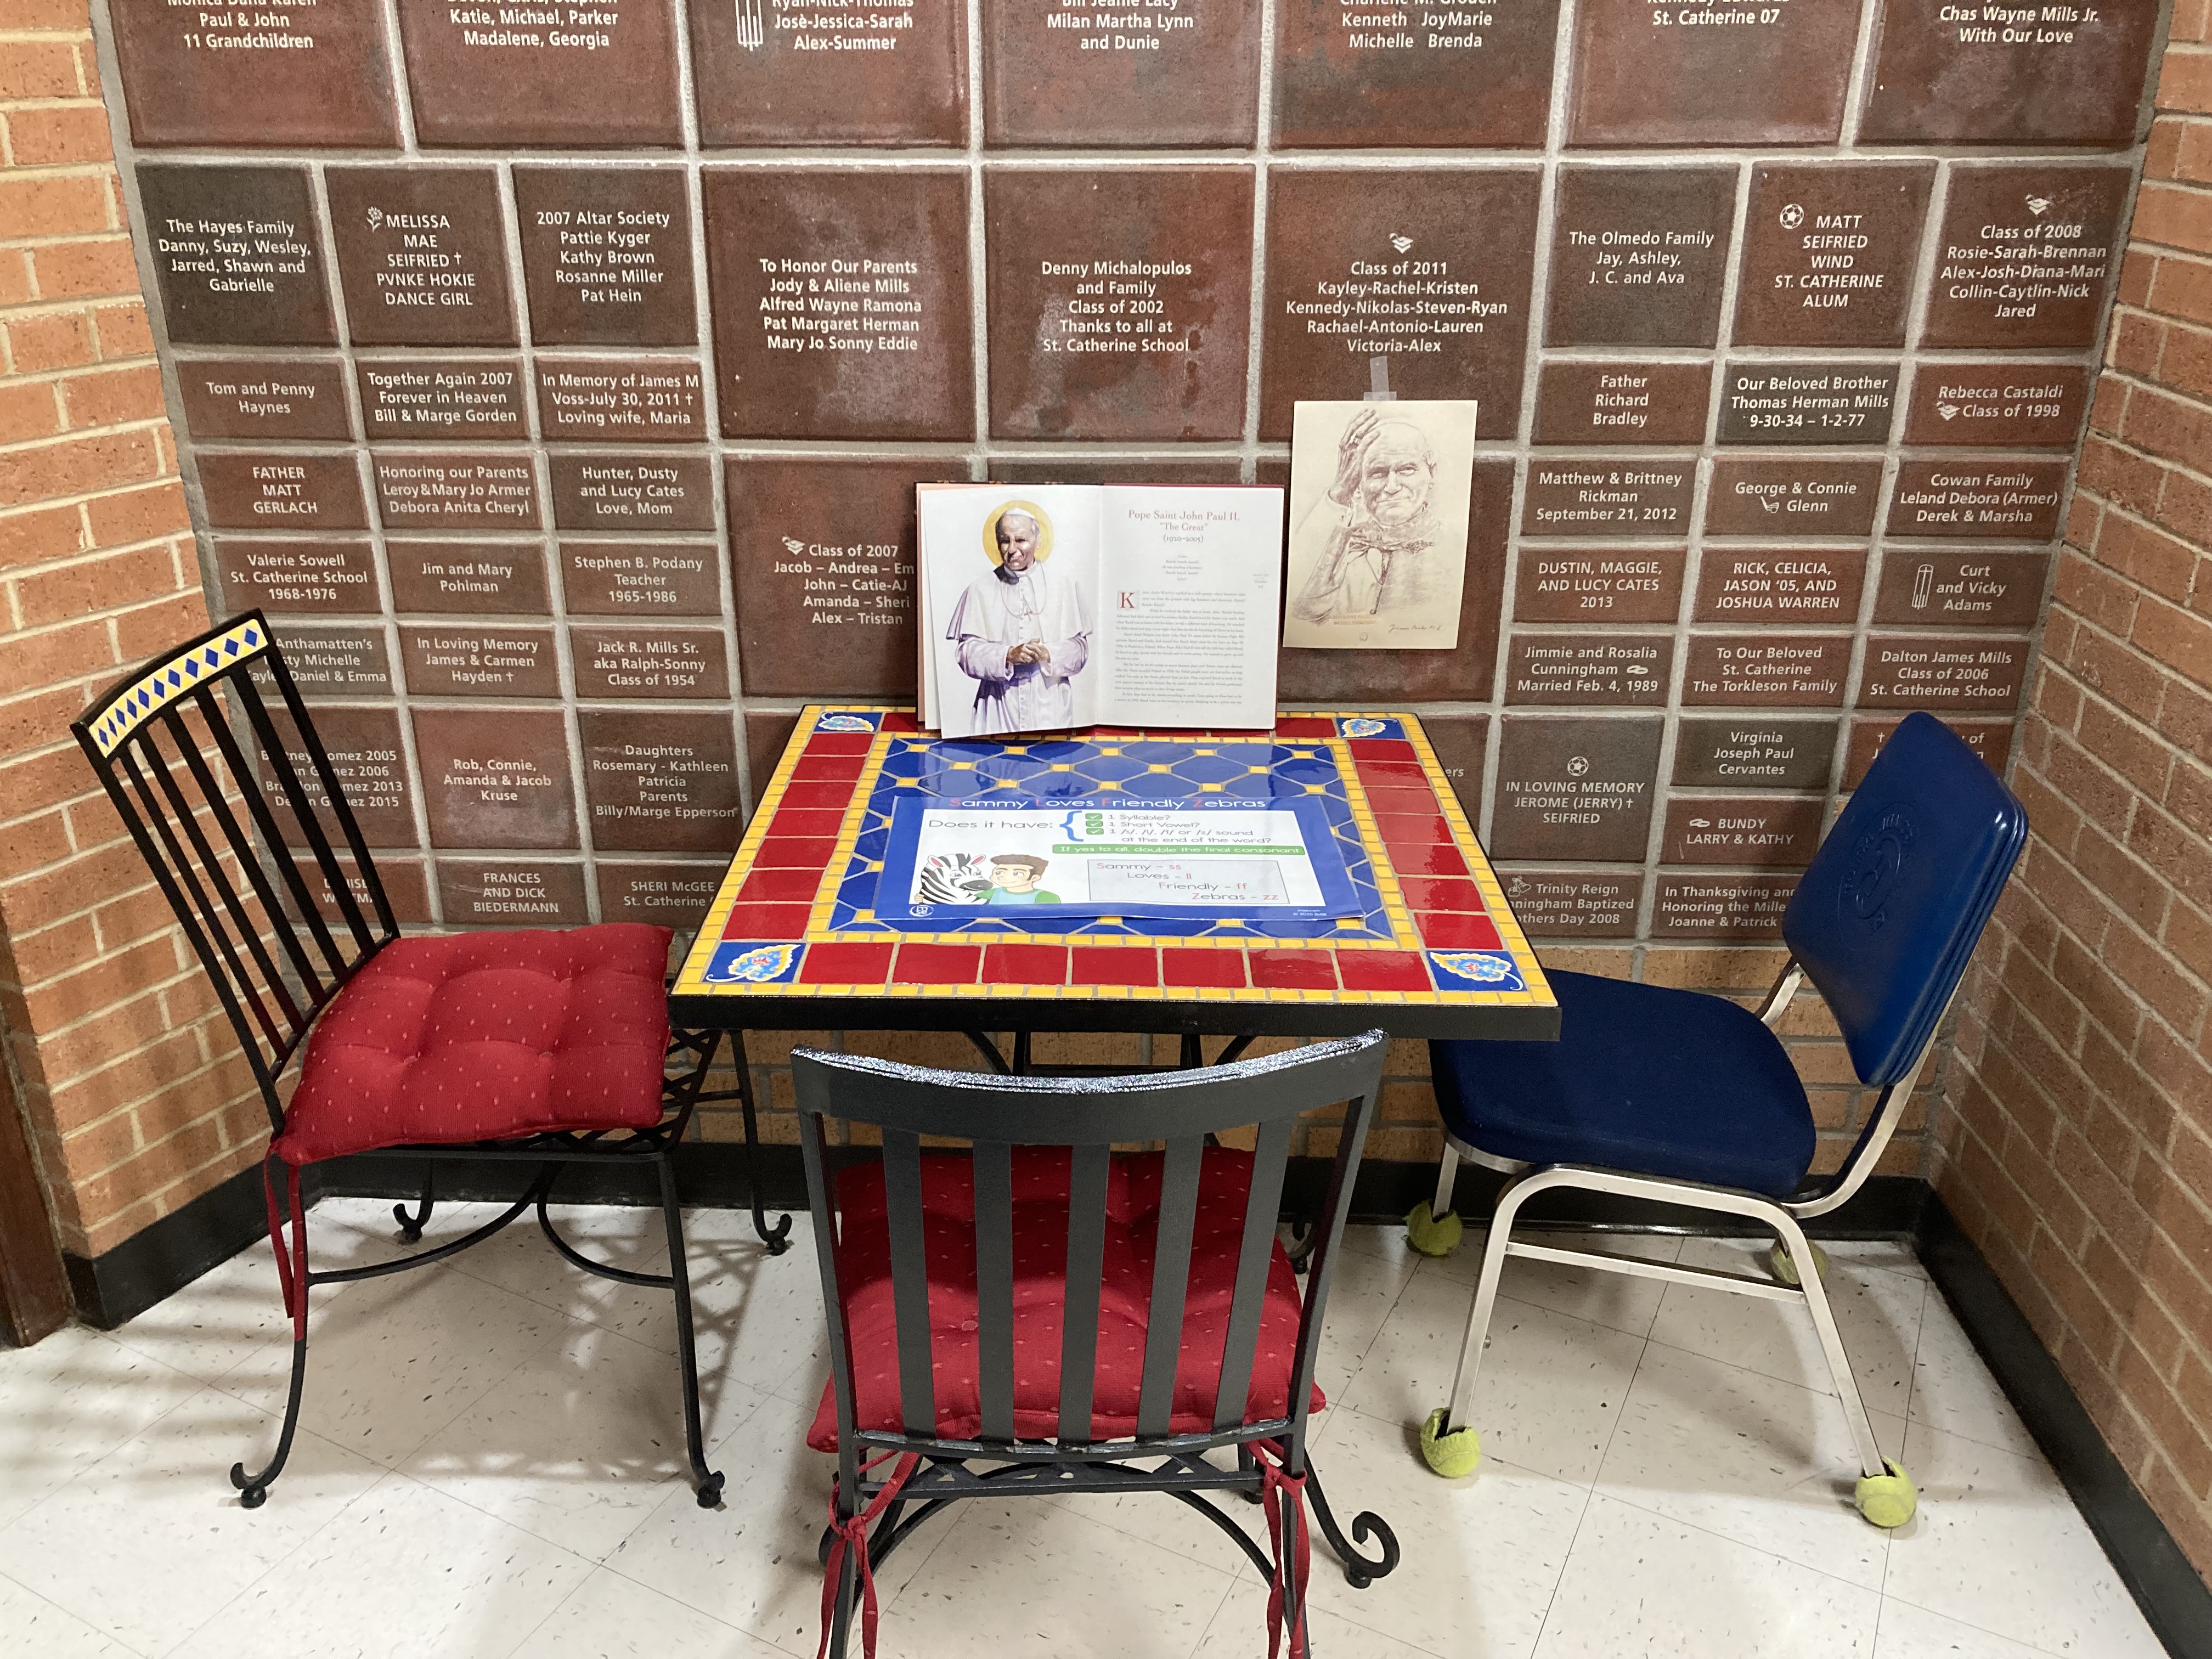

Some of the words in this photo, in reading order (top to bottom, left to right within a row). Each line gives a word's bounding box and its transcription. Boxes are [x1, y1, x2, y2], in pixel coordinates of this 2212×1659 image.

[199, 10, 233, 27] Paul
[237, 12, 250, 28] &
[253, 10, 291, 29] John
[1341, 10, 1408, 27] Kenneth
[1420, 10, 1493, 31] JoyMarie
[1652, 9, 1673, 26] St.
[1678, 8, 1756, 26] Catherine
[1759, 8, 1781, 25] 07
[183, 33, 201, 49] 11
[205, 32, 314, 50] Grandchildren
[793, 33, 897, 50] Alex-Summer
[1348, 32, 1414, 49] Michelle
[1427, 31, 1482, 48] Brenda
[165, 218, 194, 234] The
[198, 219, 242, 237] Hayes
[246, 219, 296, 238] Family
[386, 214, 451, 229] MELISSA
[1815, 215, 1863, 229] MATT
[157, 238, 210, 256] Danny,
[212, 238, 251, 257] Suzy,
[253, 239, 312, 258] Wesley,
[403, 234, 438, 249] MAE
[1802, 234, 1869, 250] SEIFRIED
[171, 257, 220, 274] Jarred,
[223, 257, 274, 273] Shawn
[278, 258, 306, 274] and
[387, 253, 450, 268] SEIFRIED
[1350, 260, 1388, 275] Class
[1392, 260, 1409, 275] of
[1412, 261, 1447, 275] 2011
[1810, 255, 1854, 269] WIND
[208, 277, 275, 293] Gabrielle
[429, 273, 476, 287] HOKIE
[1774, 274, 1794, 289] ST.
[1799, 274, 1884, 289] CATHERINE
[1317, 279, 1479, 298] Kayley-Rachel-Kristen
[385, 291, 436, 306] DANCE
[439, 292, 473, 306] GIRL
[1802, 294, 1849, 308] ALUM
[1286, 299, 1508, 318] Kennedy-Nikolas-Steven-Ryan
[1307, 318, 1484, 334] Rachael-Antonio-Lauren
[1346, 337, 1442, 353] Victoria-Alex
[366, 371, 431, 390] Together
[435, 371, 476, 390] Again
[479, 371, 513, 386] 2007
[1600, 373, 1649, 388] Father
[379, 390, 433, 404] Forever
[436, 390, 450, 404] in
[454, 390, 507, 404] Heaven
[1938, 385, 1999, 399] Rebecca
[2003, 384, 2064, 399] Castaldi
[1595, 392, 1650, 407] Richard
[374, 408, 397, 422] Bill
[401, 409, 413, 422] &
[415, 409, 461, 426] Marge
[465, 408, 517, 422] Gorden
[1962, 403, 2000, 418] Class
[2004, 403, 2023, 418] of
[2026, 404, 2061, 418] 1998
[1592, 411, 1649, 428] Bradley
[252, 466, 306, 479] FATHER
[582, 466, 634, 482] Hunter,
[637, 466, 679, 483] Dusty
[262, 483, 302, 497] MATT
[580, 483, 607, 498] and
[610, 484, 642, 500] Lucy
[646, 484, 685, 498] Cates
[1734, 481, 1787, 498] George
[1791, 481, 1803, 495] &
[1807, 481, 1858, 495] Connie
[252, 500, 318, 515] GERLACH
[595, 501, 633, 516] Love,
[636, 501, 673, 515] Mom
[1786, 498, 1829, 512] Glenn
[1128, 509, 1151, 521] Pope
[1154, 510, 1177, 520] Saint
[1179, 510, 1203, 521] John
[1206, 511, 1226, 521] Paul
[246, 553, 296, 567] Valerie
[298, 553, 346, 567] Sowell
[1538, 561, 1595, 575] DUSTIN,
[1600, 561, 1663, 575] MAGGIE,
[230, 571, 250, 583] St.
[252, 570, 319, 584] Catherine
[322, 570, 368, 584] School
[1537, 579, 1570, 592] AND
[1574, 578, 1612, 591] LUCY
[1616, 578, 1660, 591] CATES
[268, 587, 337, 600] 1968-1976
[1579, 595, 1613, 608] 2013
[416, 636, 431, 650] In
[433, 636, 479, 653] Loving
[482, 637, 539, 654] Memory
[425, 652, 466, 666] James
[469, 654, 481, 666] &
[483, 654, 535, 667] Carmen
[1880, 650, 1928, 663] Dalton
[1931, 651, 1975, 664] James
[1978, 651, 2012, 664] Mills
[451, 669, 503, 685] Hayden
[1897, 666, 1933, 680] Class
[1936, 667, 1954, 680] of
[1955, 668, 1990, 680] 2006
[1869, 683, 1888, 696] St.
[1892, 683, 1960, 697] Catherine
[1963, 684, 2011, 697] School
[1505, 781, 1521, 792] IN
[1524, 781, 1577, 793] LOVING
[1581, 781, 1646, 794] MEMORY
[949, 797, 1029, 810] Sammy
[1035, 798, 1095, 808] Loves
[1101, 798, 1185, 810] Friendly
[1192, 798, 1266, 808] Zebras
[1514, 797, 1570, 809] JEROME
[1573, 796, 1623, 811] (JERRY)
[928, 820, 978, 828] Does
[1001, 821, 1053, 829] have:
[1542, 812, 1601, 824] SEIFRIED
[1717, 817, 1767, 830] BUNDY
[1686, 833, 1730, 845] LARRY
[1733, 833, 1744, 845] &
[1747, 833, 1794, 845] KATHY
[482, 872, 541, 884] FRANCES
[482, 887, 512, 898] AND
[515, 887, 546, 899] DICK
[473, 901, 560, 913] BIEDERMANN
